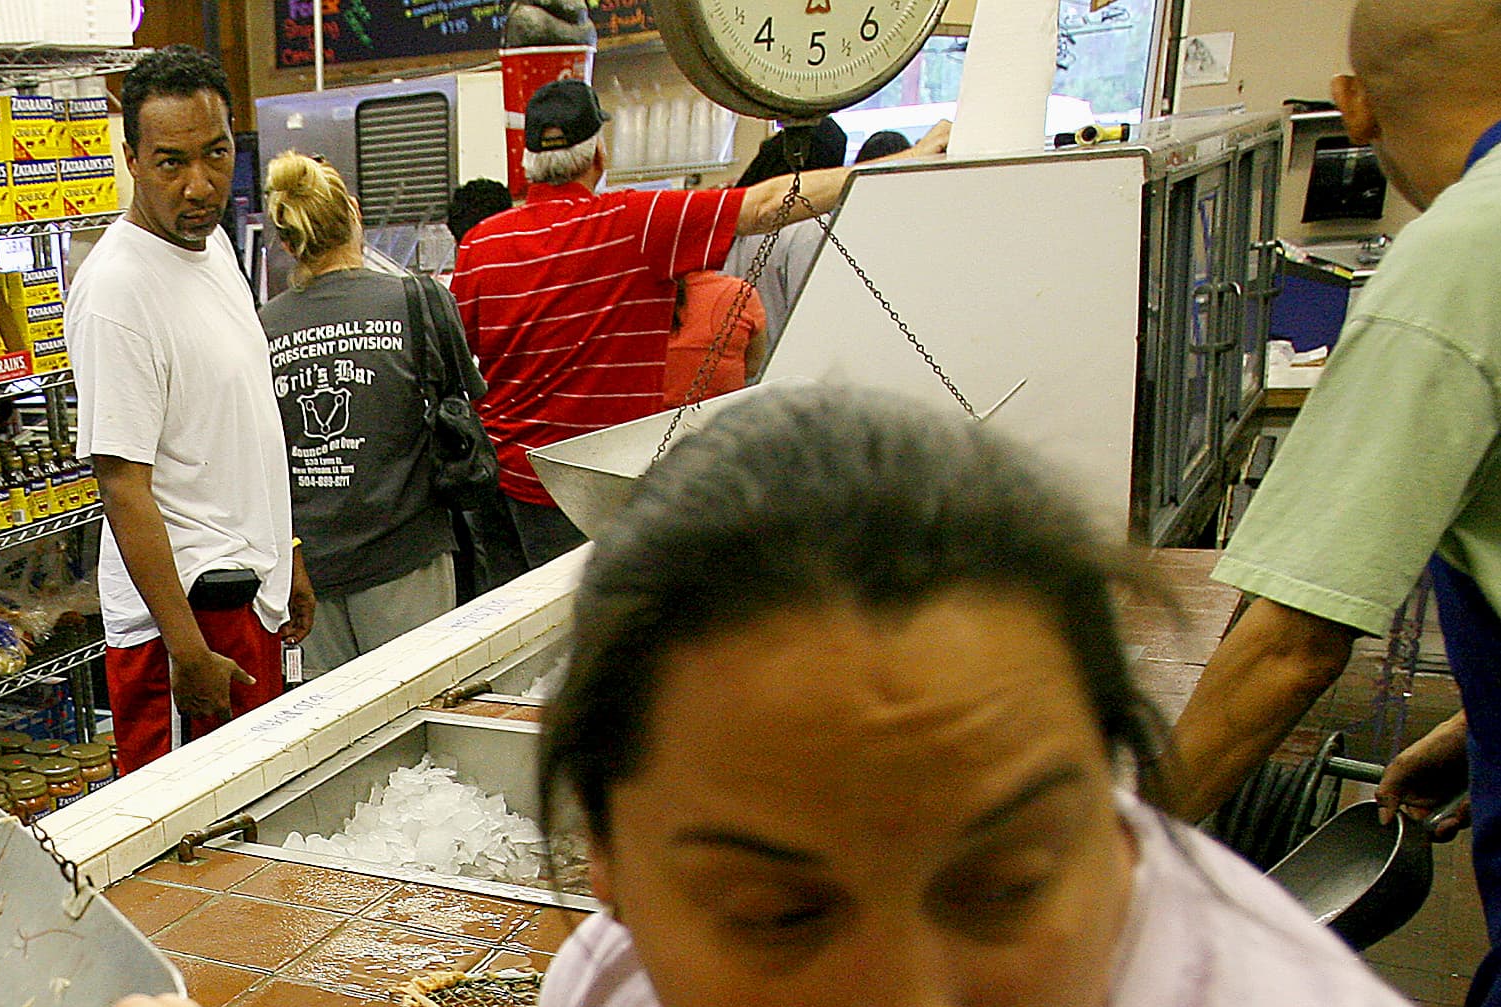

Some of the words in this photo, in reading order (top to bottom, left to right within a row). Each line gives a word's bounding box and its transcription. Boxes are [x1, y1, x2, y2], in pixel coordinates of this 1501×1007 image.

[753, 16, 775, 52] 4
[860, 6, 879, 42] 6
[807, 31, 827, 66] 5
[269, 335, 291, 354] AKA
[293, 321, 363, 345] KICKBALL
[365, 320, 402, 335] 2010
[272, 341, 336, 368] CRESCENT
[338, 336, 403, 353] DIVISION
[334, 359, 376, 385] Bar
